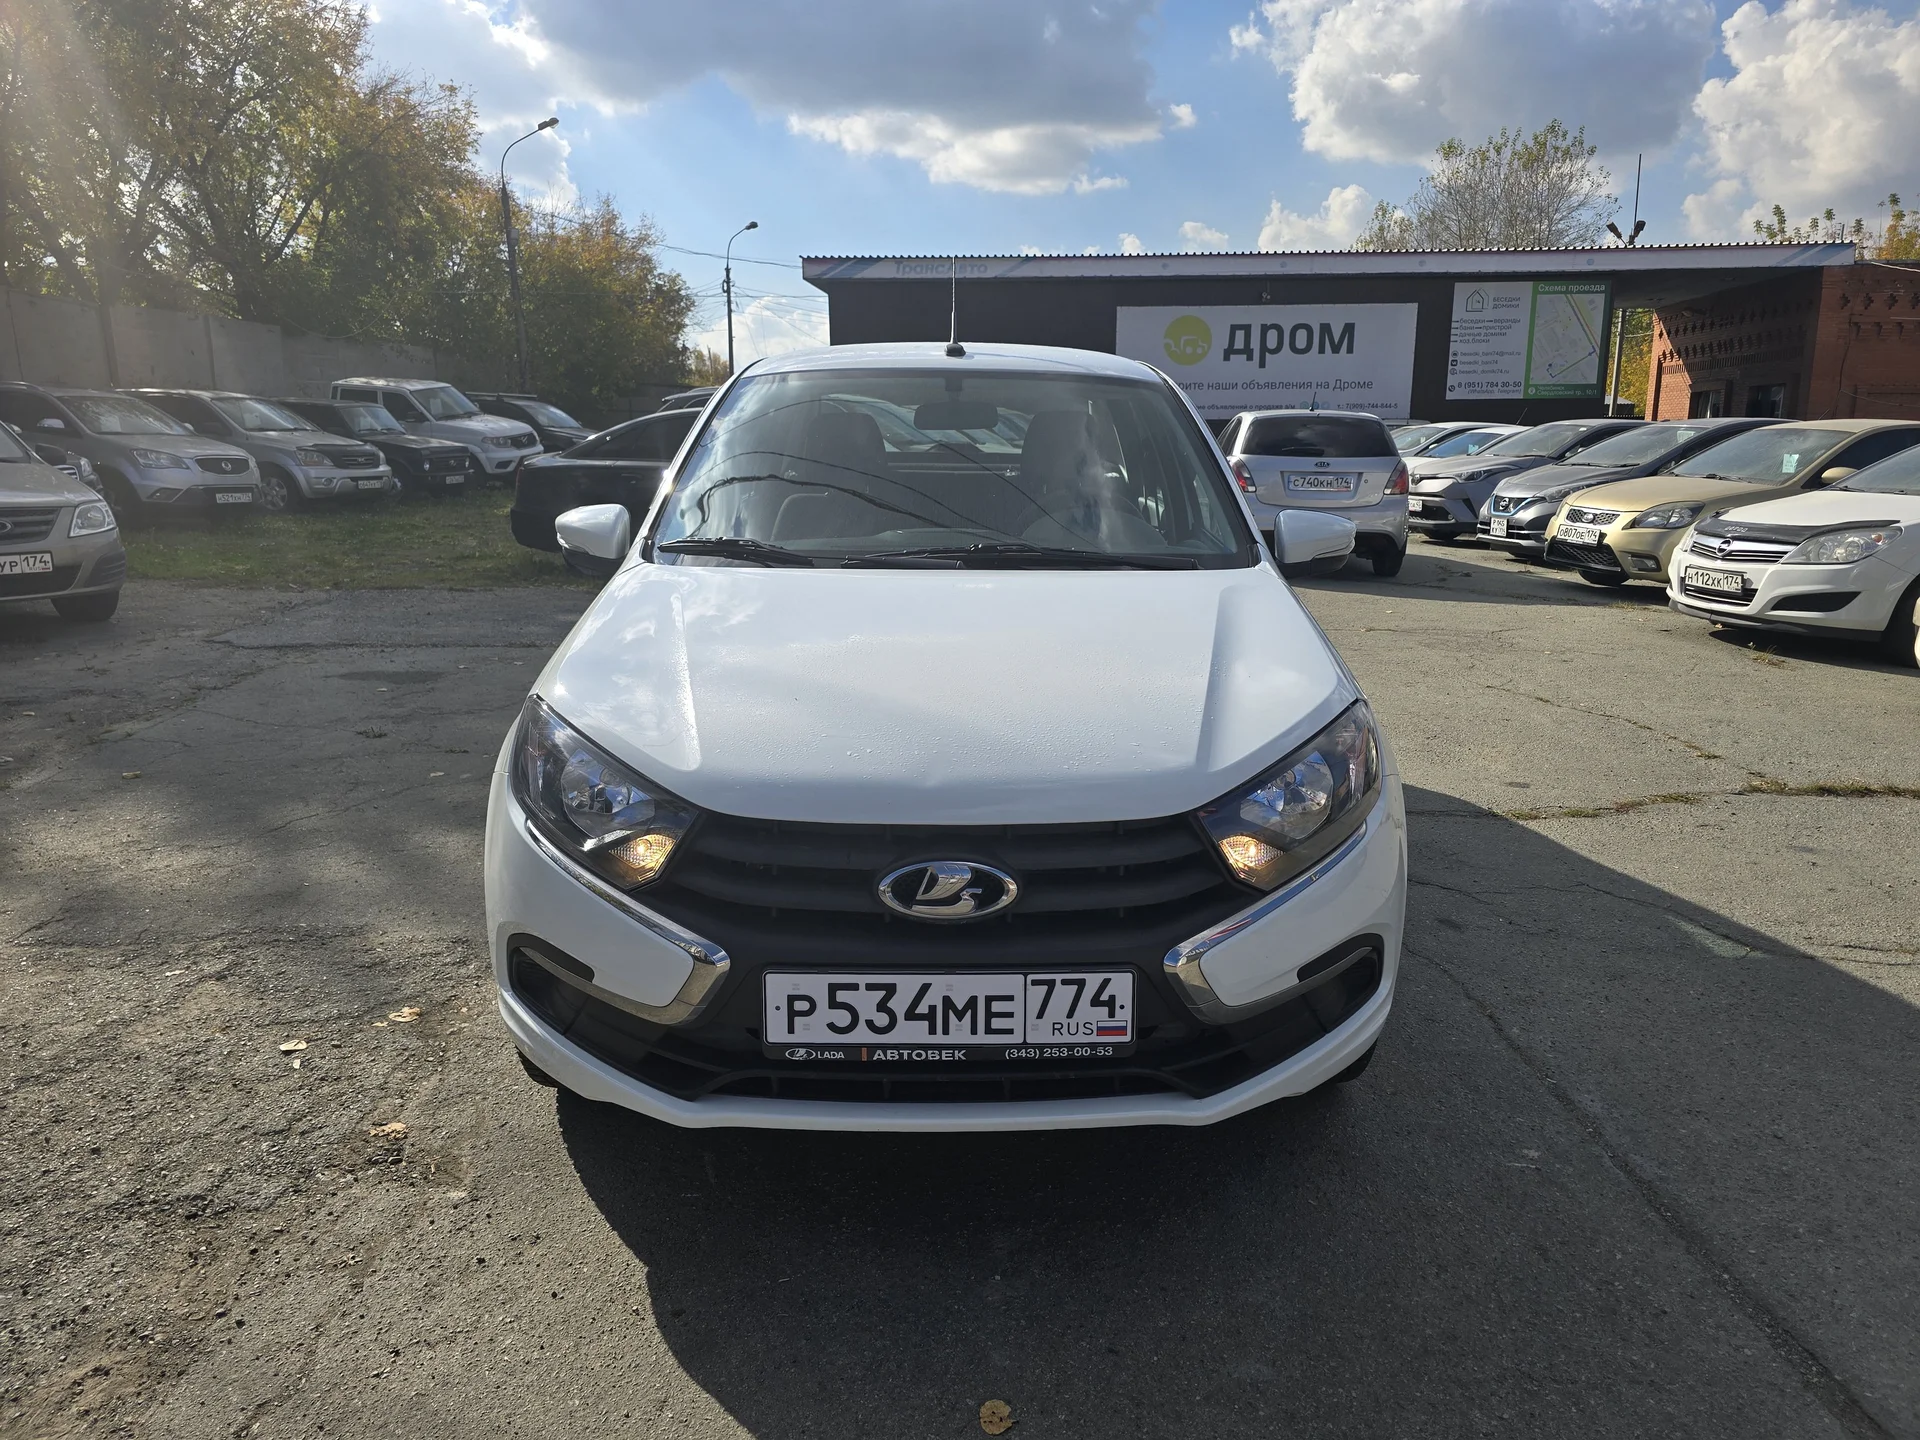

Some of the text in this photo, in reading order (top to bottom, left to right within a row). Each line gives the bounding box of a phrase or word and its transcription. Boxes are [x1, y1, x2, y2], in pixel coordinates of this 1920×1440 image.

[1538, 284, 1605, 293] Схема проезда
[1222, 321, 1356, 369] дром
[1207, 381, 1239, 391] наши
[1241, 379, 1313, 391] объявления
[1315, 380, 1330, 390] на
[1332, 378, 1374, 392] Дроме
[1457, 381, 1463, 389] 8
[1464, 381, 1484, 390] (951)
[22, 554, 48, 568] 174
[1724, 575, 1740, 588] 174
[786, 977, 1116, 1036] Р534МЕ 774
[1052, 1021, 1094, 1037] RUS
[817, 1050, 845, 1059] LADA
[872, 1046, 1113, 1061] АВТОВЕК (343) 253-00-53
